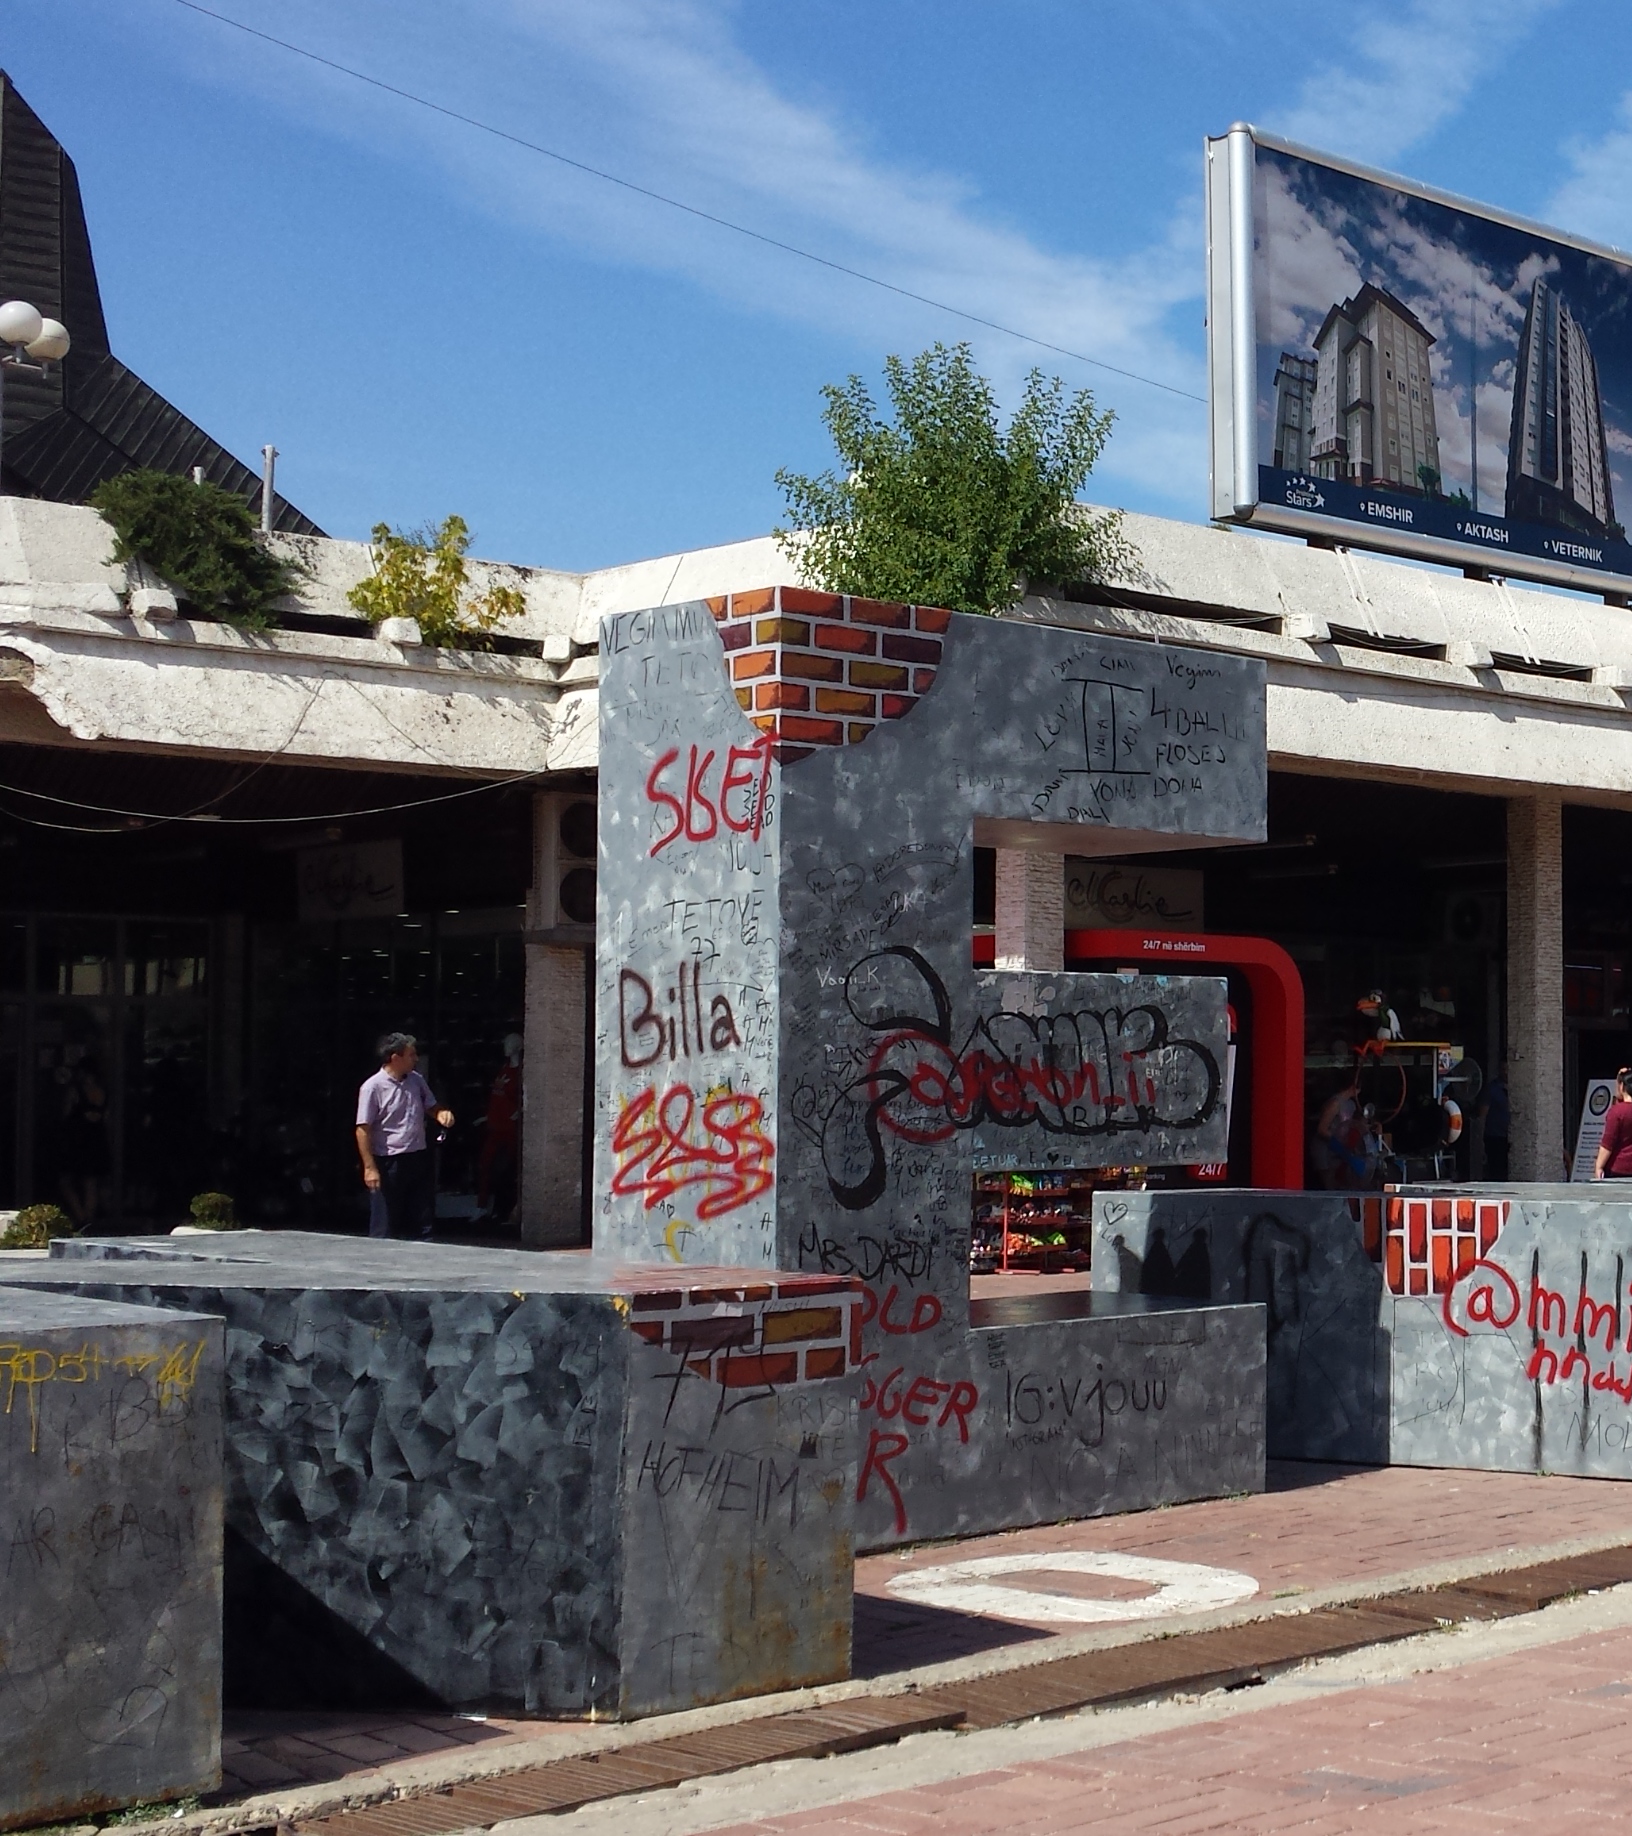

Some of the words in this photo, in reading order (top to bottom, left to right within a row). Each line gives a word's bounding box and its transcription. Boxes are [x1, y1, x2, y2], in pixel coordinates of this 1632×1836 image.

[1286, 491, 1313, 508] Stars
[1367, 501, 1414, 524] EMSHIR
[1464, 522, 1509, 544] AKTASH
[1551, 540, 1603, 563] VETERNIK
[1143, 940, 1161, 950] 24/7
[1174, 941, 1206, 952] shërbim
